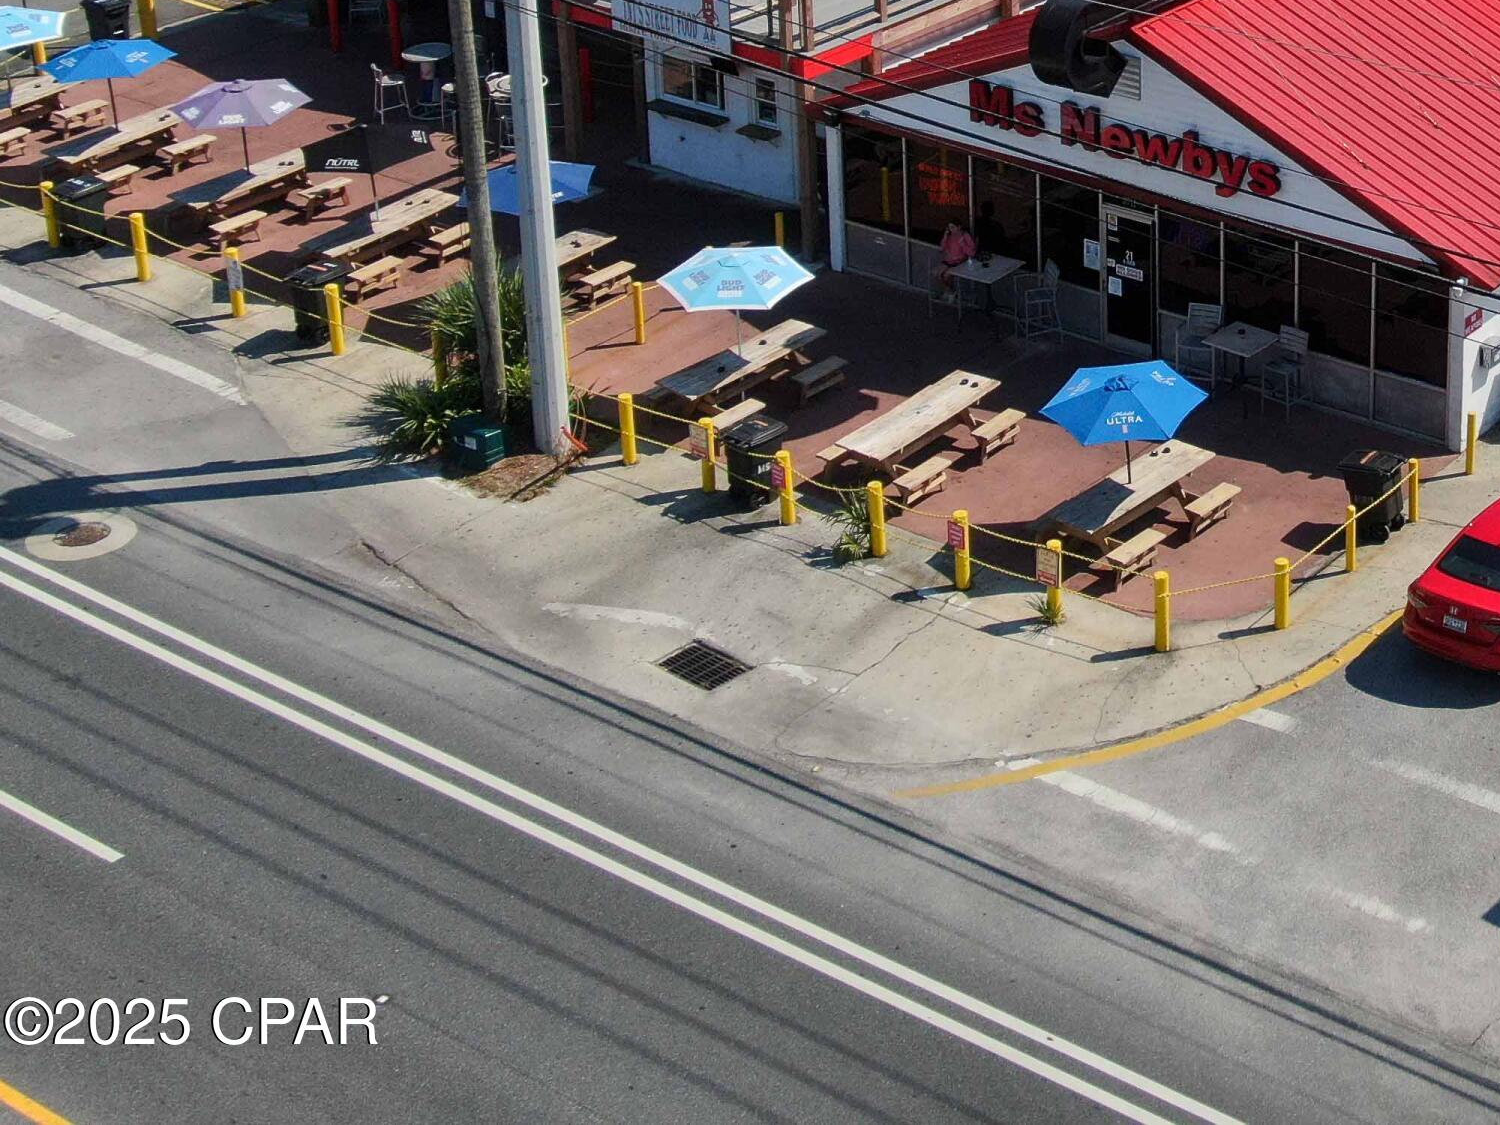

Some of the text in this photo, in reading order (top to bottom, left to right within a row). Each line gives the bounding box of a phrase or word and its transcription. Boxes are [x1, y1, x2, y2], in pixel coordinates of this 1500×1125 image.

[969, 77, 1046, 137] Ms
[1059, 100, 1282, 198] Newbys
[1106, 415, 1144, 426] ULTRA
